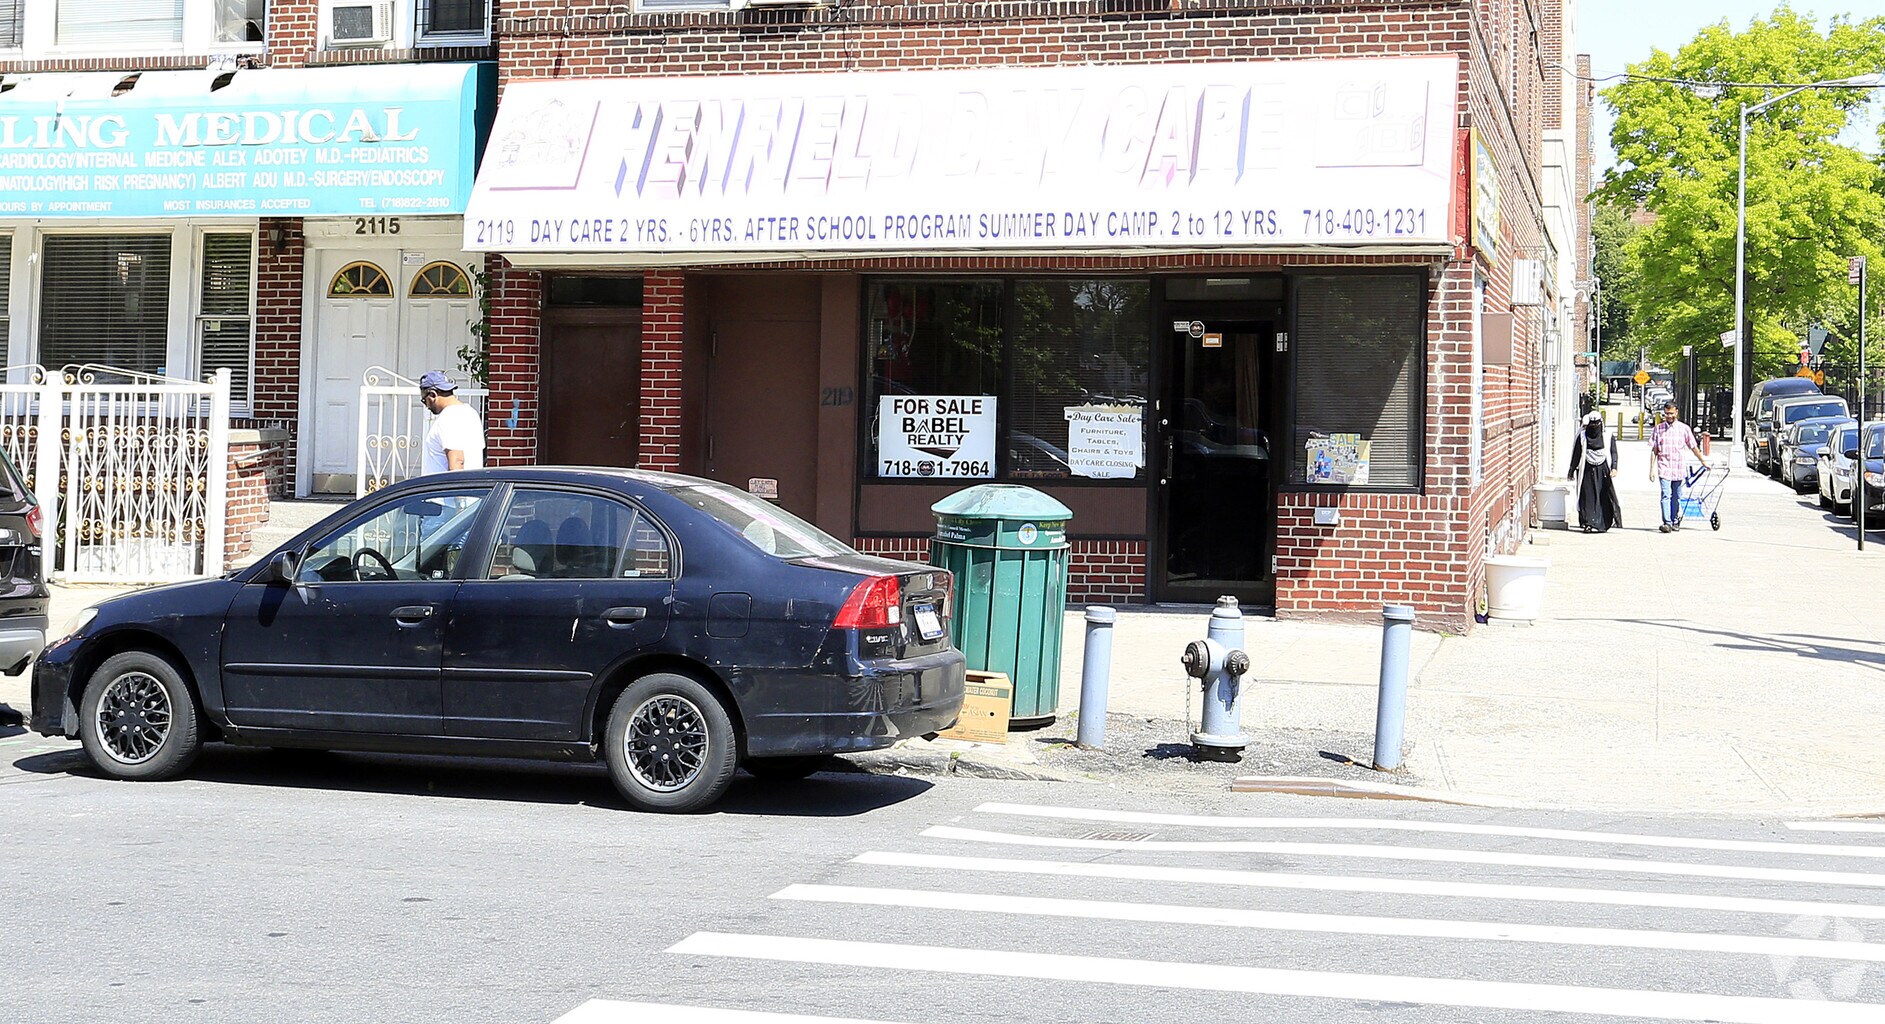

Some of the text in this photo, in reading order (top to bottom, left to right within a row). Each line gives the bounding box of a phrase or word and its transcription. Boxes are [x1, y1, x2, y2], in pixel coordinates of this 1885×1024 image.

[0, 106, 420, 149] LING MEDICAL
[1101, 82, 1286, 186] CARE
[0, 146, 429, 170] ARDIOLOGY/INTERNAL MEDICINE ALEX ADOTEY M.D.-PEDIATRICS
[94, 174, 120, 191] RISK
[124, 172, 196, 191] PREGNANCY)
[202, 171, 246, 189] ALBERT
[253, 171, 277, 188] ADU
[283, 169, 445, 188] M.D.-SURGERY/ENDOSCOPY
[31, 201, 44, 212] BY
[48, 201, 112, 211] APPOINTMENT
[163, 200, 191, 211] MOST
[196, 199, 256, 210] INSURANCES
[261, 198, 311, 209] ACCEPTED
[359, 197, 376, 208] TEL
[355, 217, 401, 235] 2115
[477, 219, 514, 243] 2119
[530, 219, 564, 243] DAY
[570, 218, 613, 243] CARE
[620, 218, 629, 243] 2
[636, 218, 672, 242] YRS.
[744, 217, 799, 241] AFTER
[806, 216, 876, 241] SCHOOL
[884, 214, 971, 239] PROGRAM
[978, 212, 1056, 238] SUMMER
[1064, 212, 1099, 237] DAY
[1171, 210, 1181, 235] 2
[1188, 212, 1205, 235] to
[1213, 210, 1233, 235] 12
[1241, 210, 1282, 235] YRS.
[1303, 208, 1426, 235] 718-409-1231
[893, 398, 982, 415] FOR SALE
[902, 417, 970, 433] BABEL
[1072, 412, 1137, 424] Day Care Sale
[907, 434, 964, 445] REALTY
[1330, 434, 1360, 446] SALE
[884, 460, 989, 476] 718-1-7964
[1085, 459, 1105, 467] CARE
[1105, 460, 1134, 468] CLOSING
[1092, 470, 1111, 478] SALE
